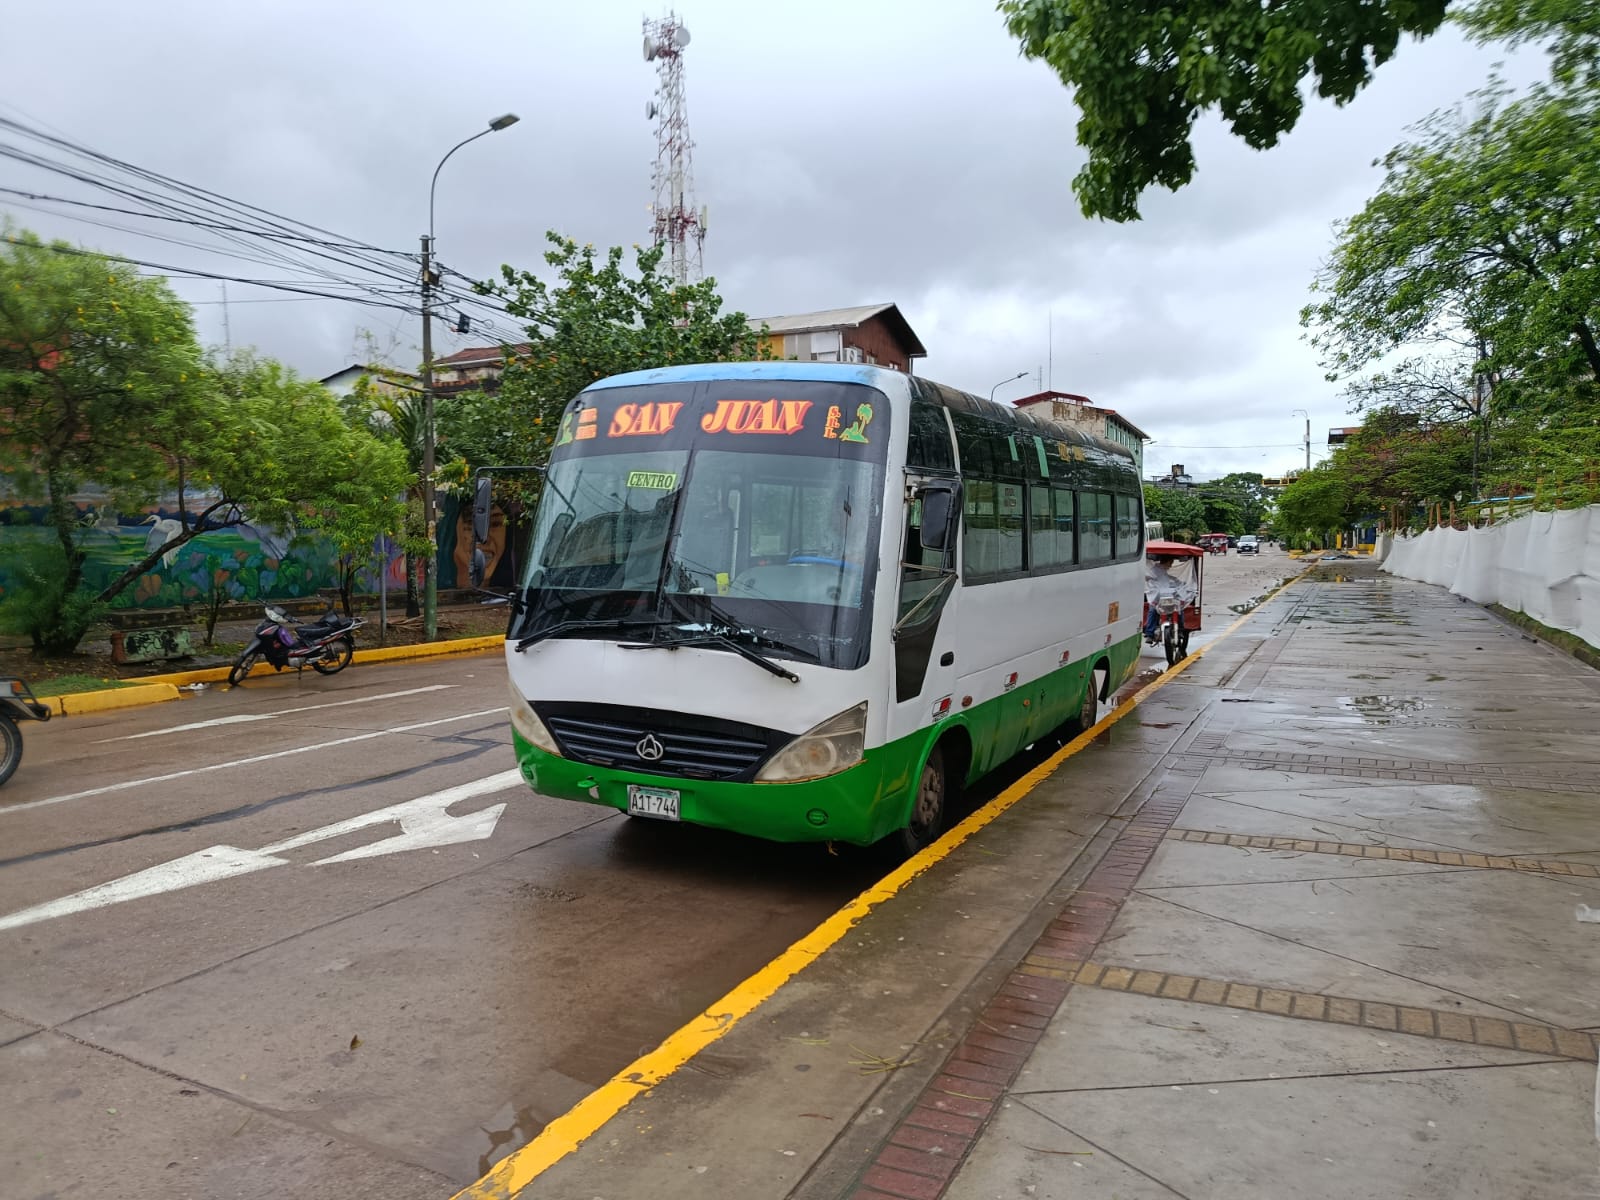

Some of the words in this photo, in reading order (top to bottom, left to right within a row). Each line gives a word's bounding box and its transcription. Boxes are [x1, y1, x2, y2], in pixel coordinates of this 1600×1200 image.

[608, 402, 684, 437] SAN
[701, 398, 813, 434] JUAN
[629, 473, 673, 488] CENTRO
